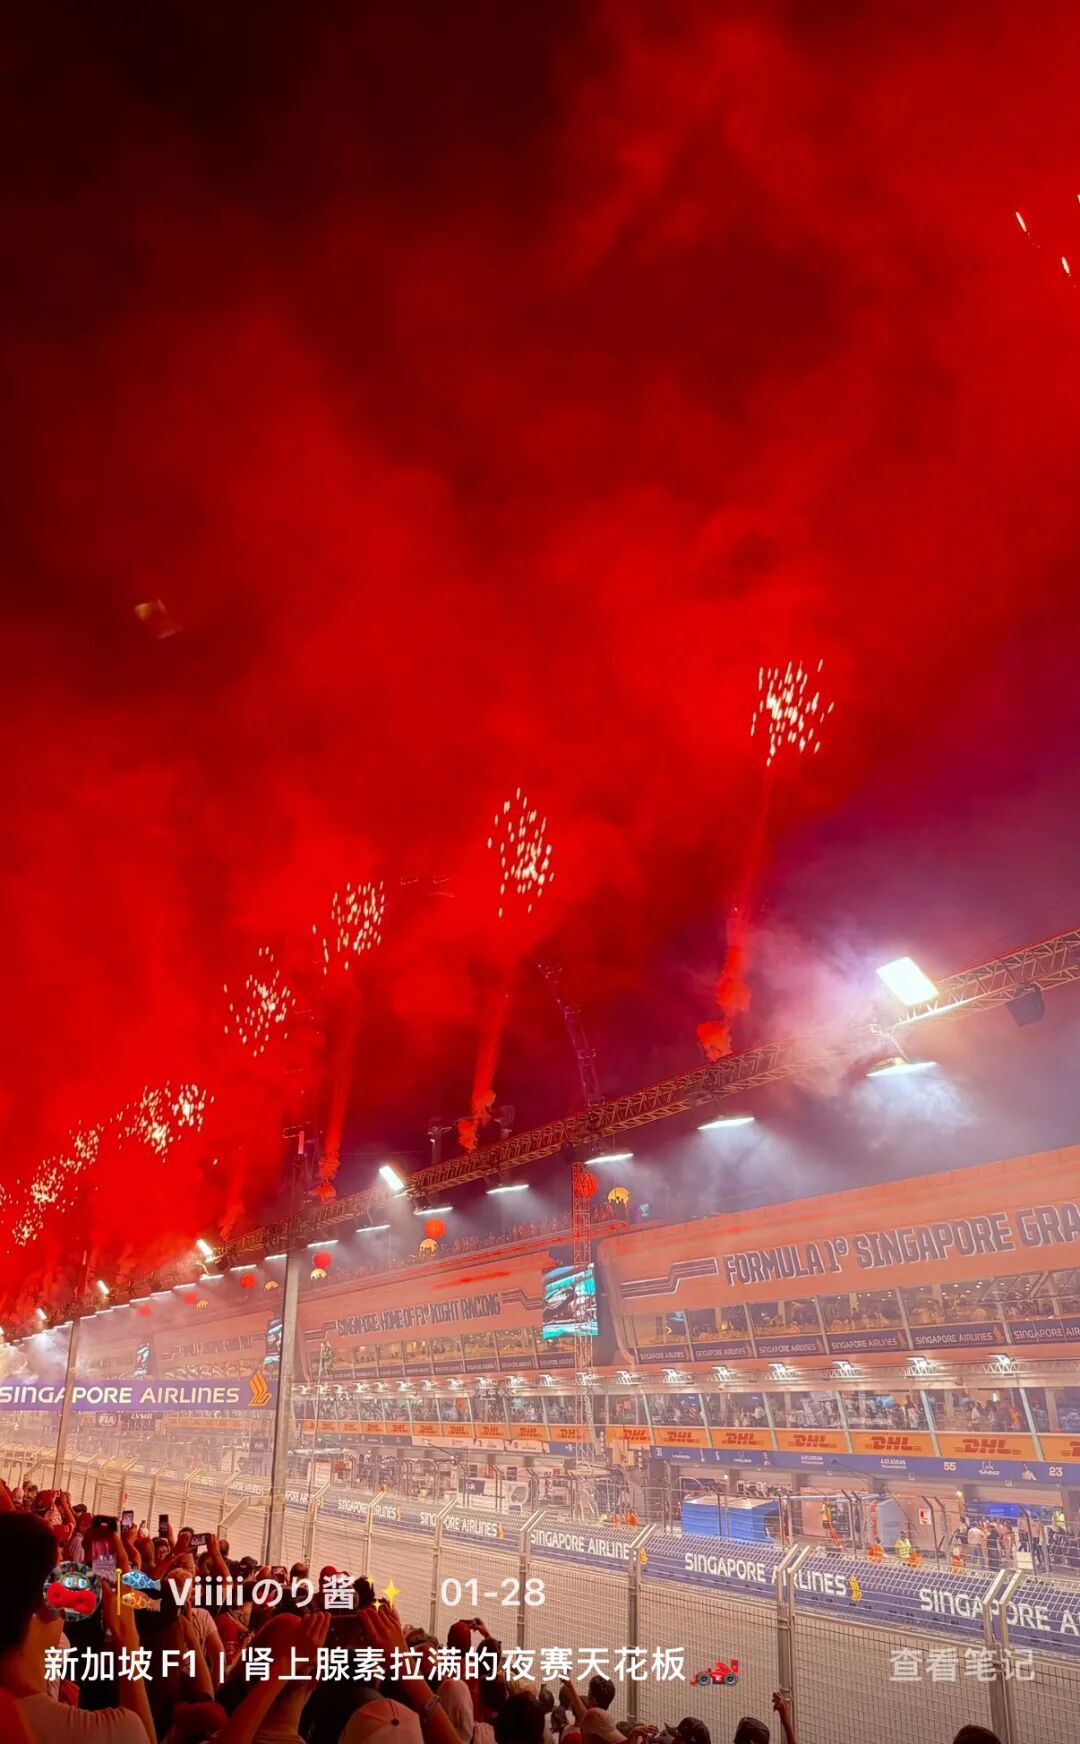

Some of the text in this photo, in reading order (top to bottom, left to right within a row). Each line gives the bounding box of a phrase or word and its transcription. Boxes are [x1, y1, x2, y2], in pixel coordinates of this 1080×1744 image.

[723, 1242, 826, 1287] FORMULA
[852, 1212, 1016, 1270] SINGAPORE
[915, 1332, 993, 1345] SINGAPORE AIRLINES
[1013, 1328, 1064, 1340] SINGAPORE
[758, 1344, 790, 1354] SINGAPORE
[831, 1337, 898, 1350] SINGAPORE AIRLINES
[0, 1386, 240, 1404] SINGAPORE AIRLINES
[100, 1415, 114, 1425] FIA
[666, 1430, 697, 1443] DHL
[726, 1432, 757, 1445] DHL
[793, 1434, 830, 1448] DHL
[871, 1436, 913, 1451] DHL
[962, 1438, 1011, 1455] DHL
[943, 1461, 957, 1471] 55
[1048, 1466, 1063, 1477] 23
[420, 1512, 498, 1537] SINGORE AIRLINES
[530, 1529, 585, 1553] SINGAPORE
[684, 1552, 766, 1584] SINGAPORE
[919, 1588, 1051, 1631] SINGAPORE
